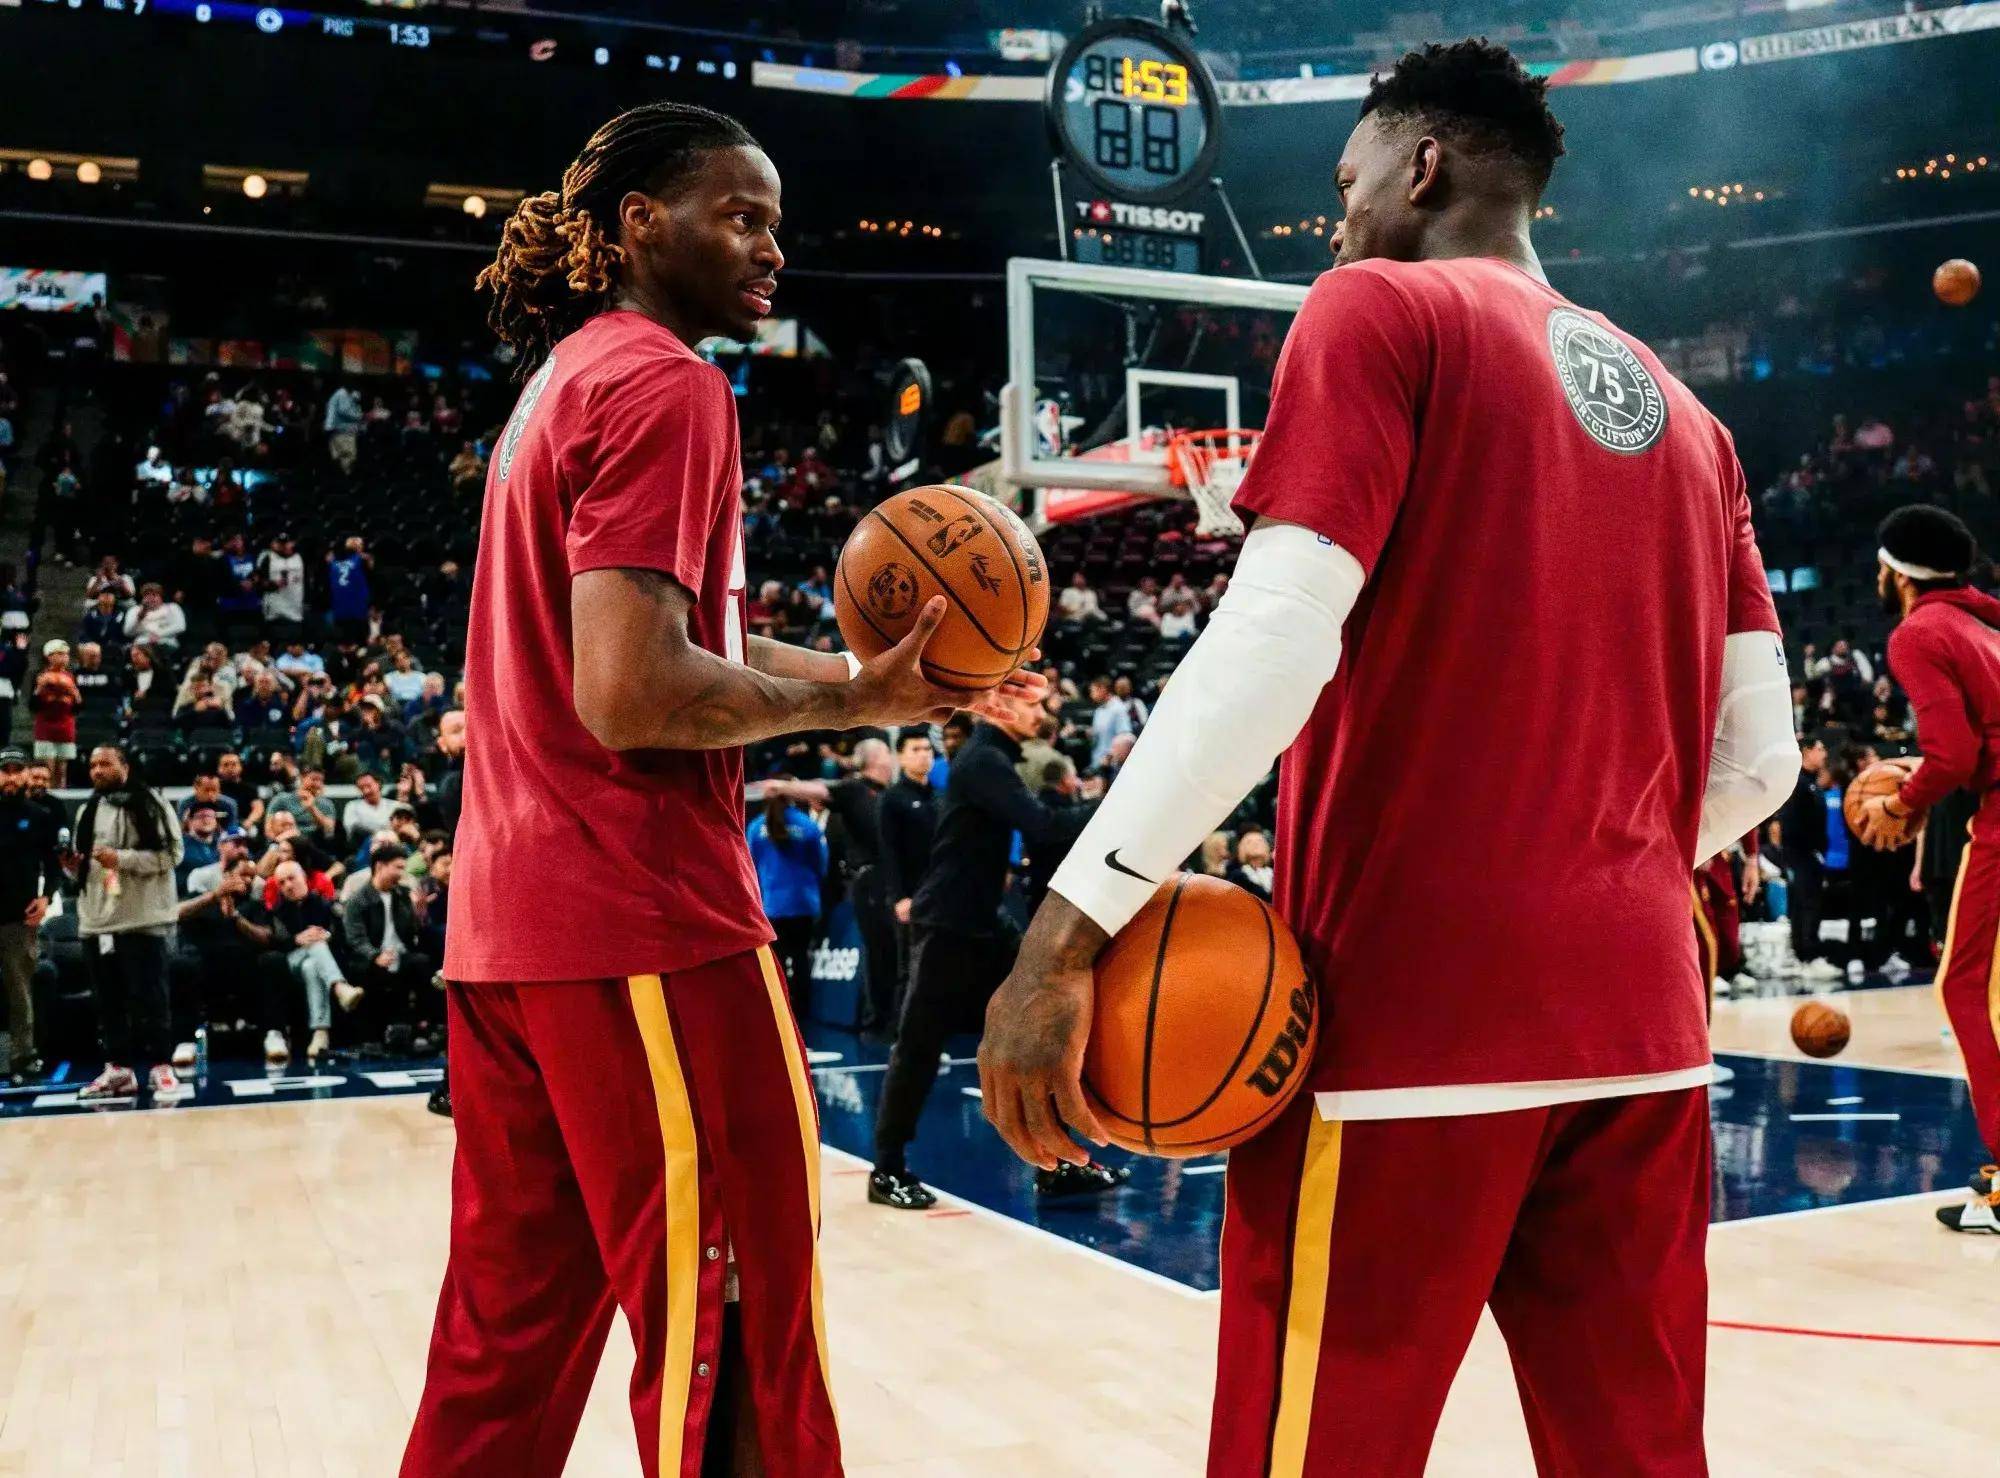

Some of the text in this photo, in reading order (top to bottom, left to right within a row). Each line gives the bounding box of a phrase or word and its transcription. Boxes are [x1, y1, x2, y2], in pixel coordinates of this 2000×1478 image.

[1121, 56, 1189, 106] 1:53
[1111, 202, 1205, 233] TISSOT
[1579, 353, 1625, 405] 75
[1591, 420, 1645, 445] CLIFTON
[1643, 387, 1660, 432] LLOYD
